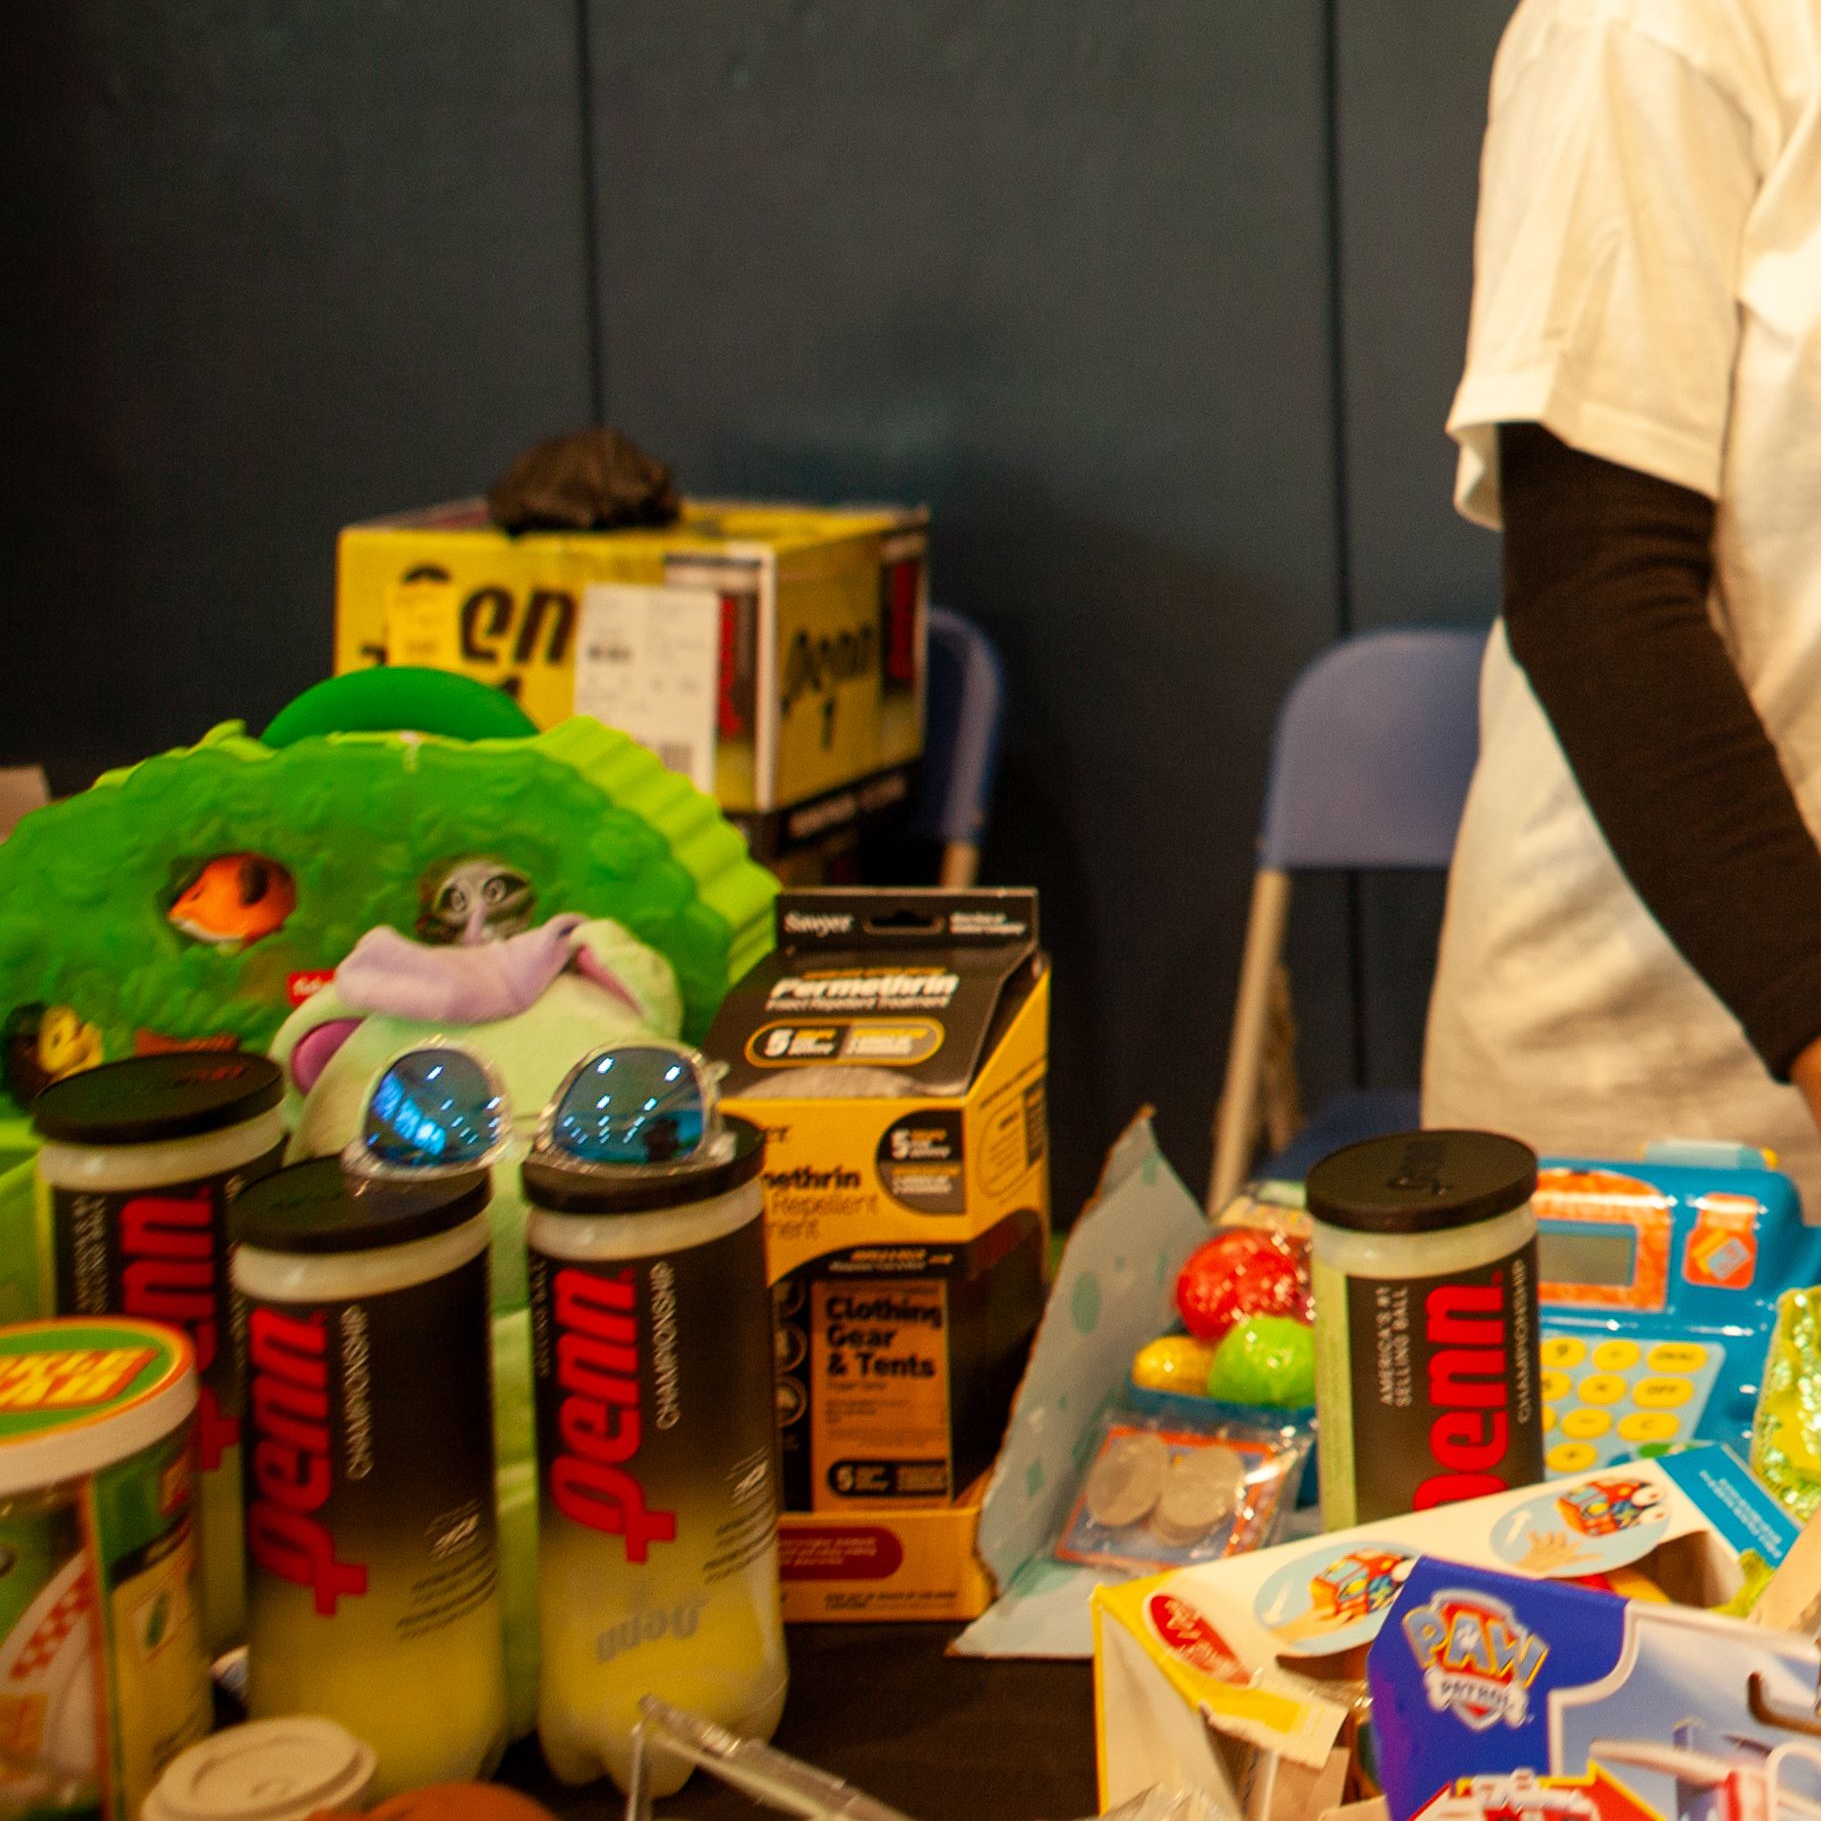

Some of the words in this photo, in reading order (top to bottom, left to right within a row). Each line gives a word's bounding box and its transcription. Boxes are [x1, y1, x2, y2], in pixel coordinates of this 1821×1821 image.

[769, 973, 961, 1000] Permethrin
[649, 1259, 682, 1430] CHAMPIONSHIP
[825, 1296, 943, 1330] Clothing
[825, 1325, 897, 1349] Gear
[1392, 1286, 1410, 1331] BALL
[1511, 1258, 1532, 1424] CHAMPIONSHIP
[827, 1353, 847, 1378] &
[856, 1353, 936, 1379] Tents
[1375, 1313, 1394, 1407] AMERICA'S
[1392, 1334, 1412, 1408] SELLING
[549, 1266, 677, 1565] penn
[247, 1304, 369, 1618] penn
[1402, 1603, 1551, 1691] PAW
